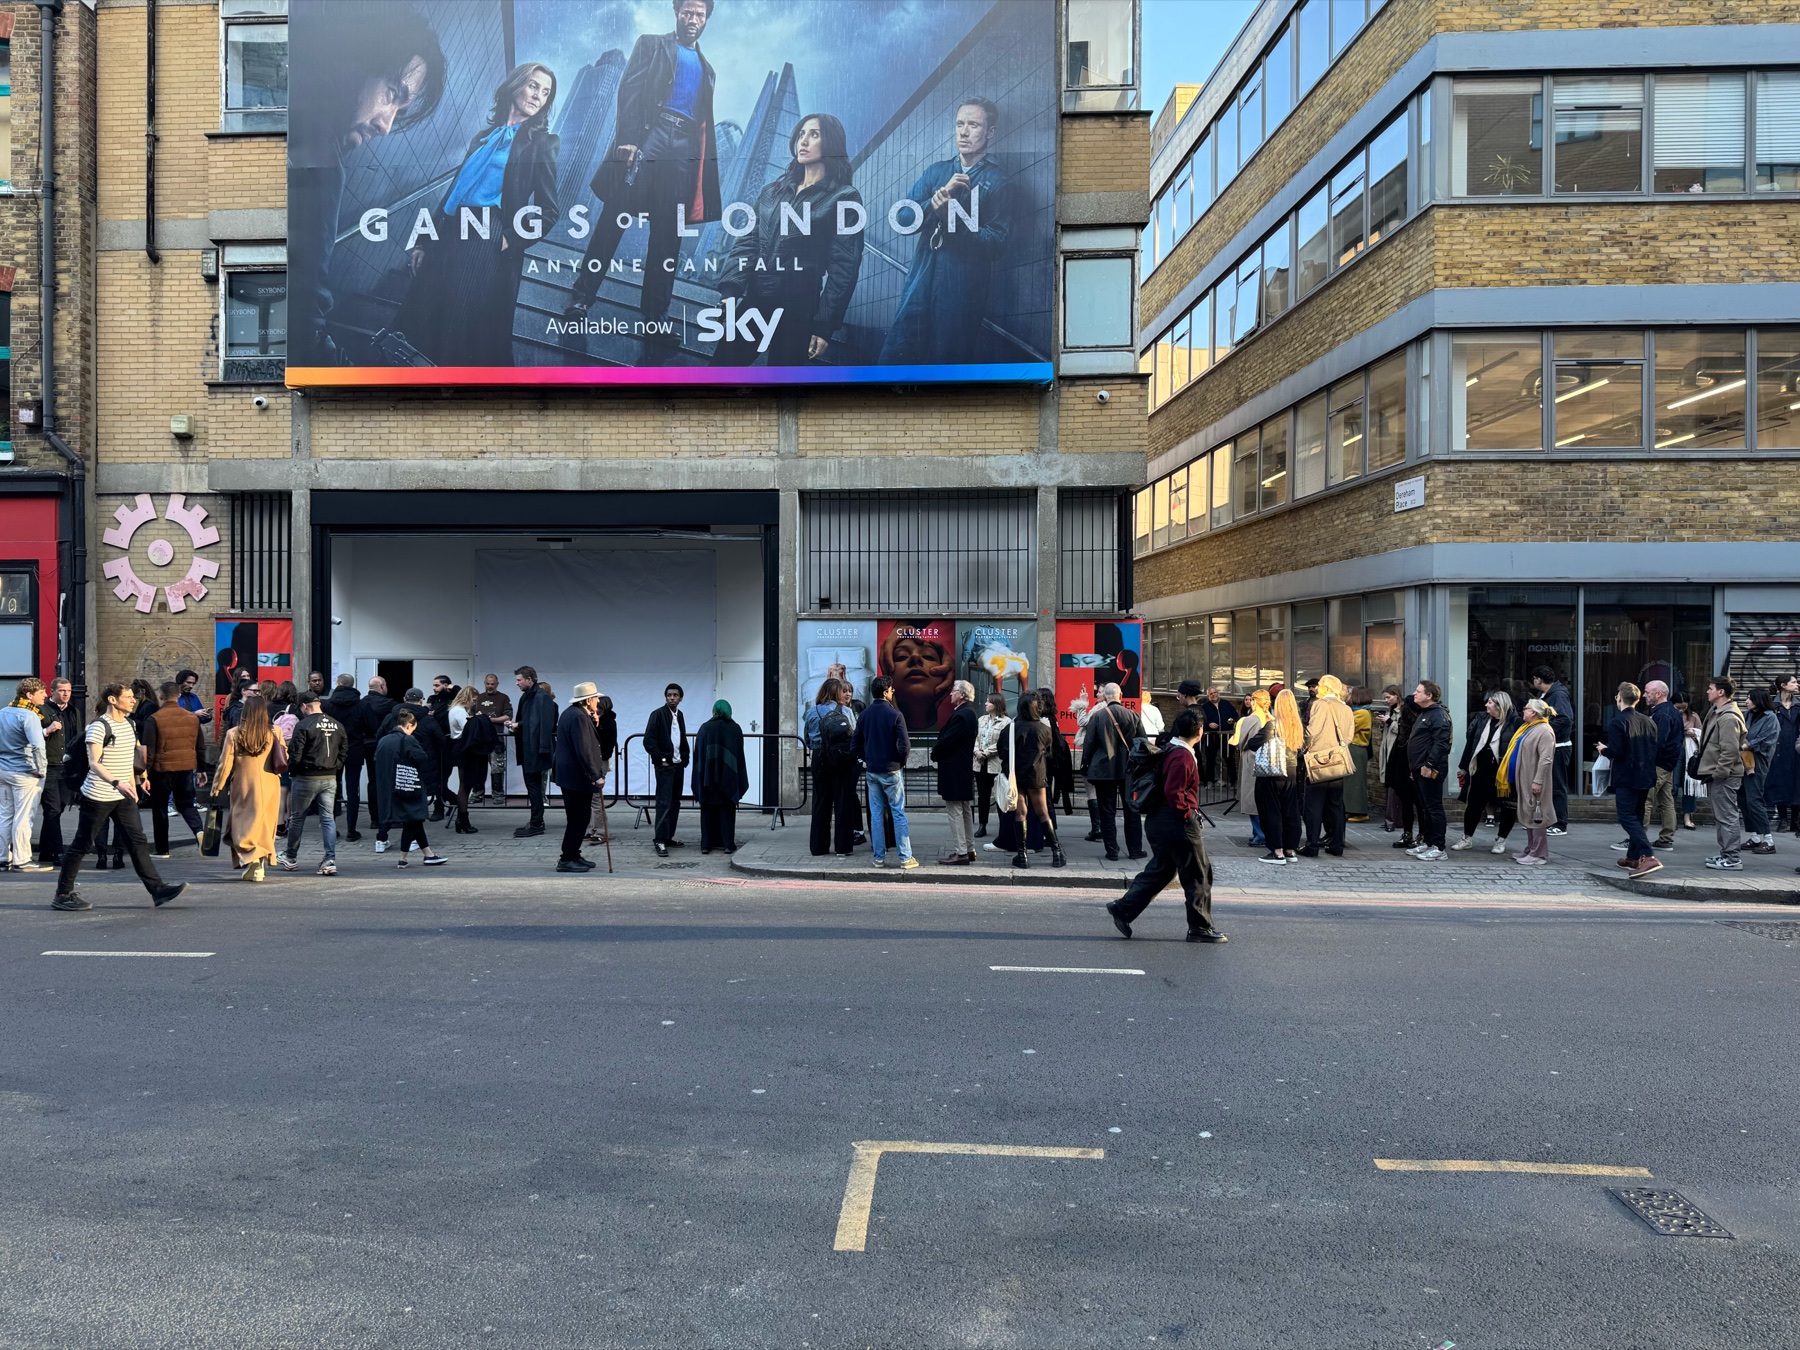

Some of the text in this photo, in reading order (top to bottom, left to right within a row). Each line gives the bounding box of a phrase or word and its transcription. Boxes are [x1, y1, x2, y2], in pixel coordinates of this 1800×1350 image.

[359, 184, 980, 251] GANGS OF LONDON
[527, 256, 804, 273] ANYONE CAN FALL
[545, 317, 673, 335] Available now
[696, 297, 785, 353] sky
[1396, 489, 1415, 500] Dereham
[1396, 501, 1408, 509] Place
[816, 628, 859, 636] CLUSTER
[896, 628, 939, 636] CLUSTER
[975, 628, 1018, 636] CLUSTER
